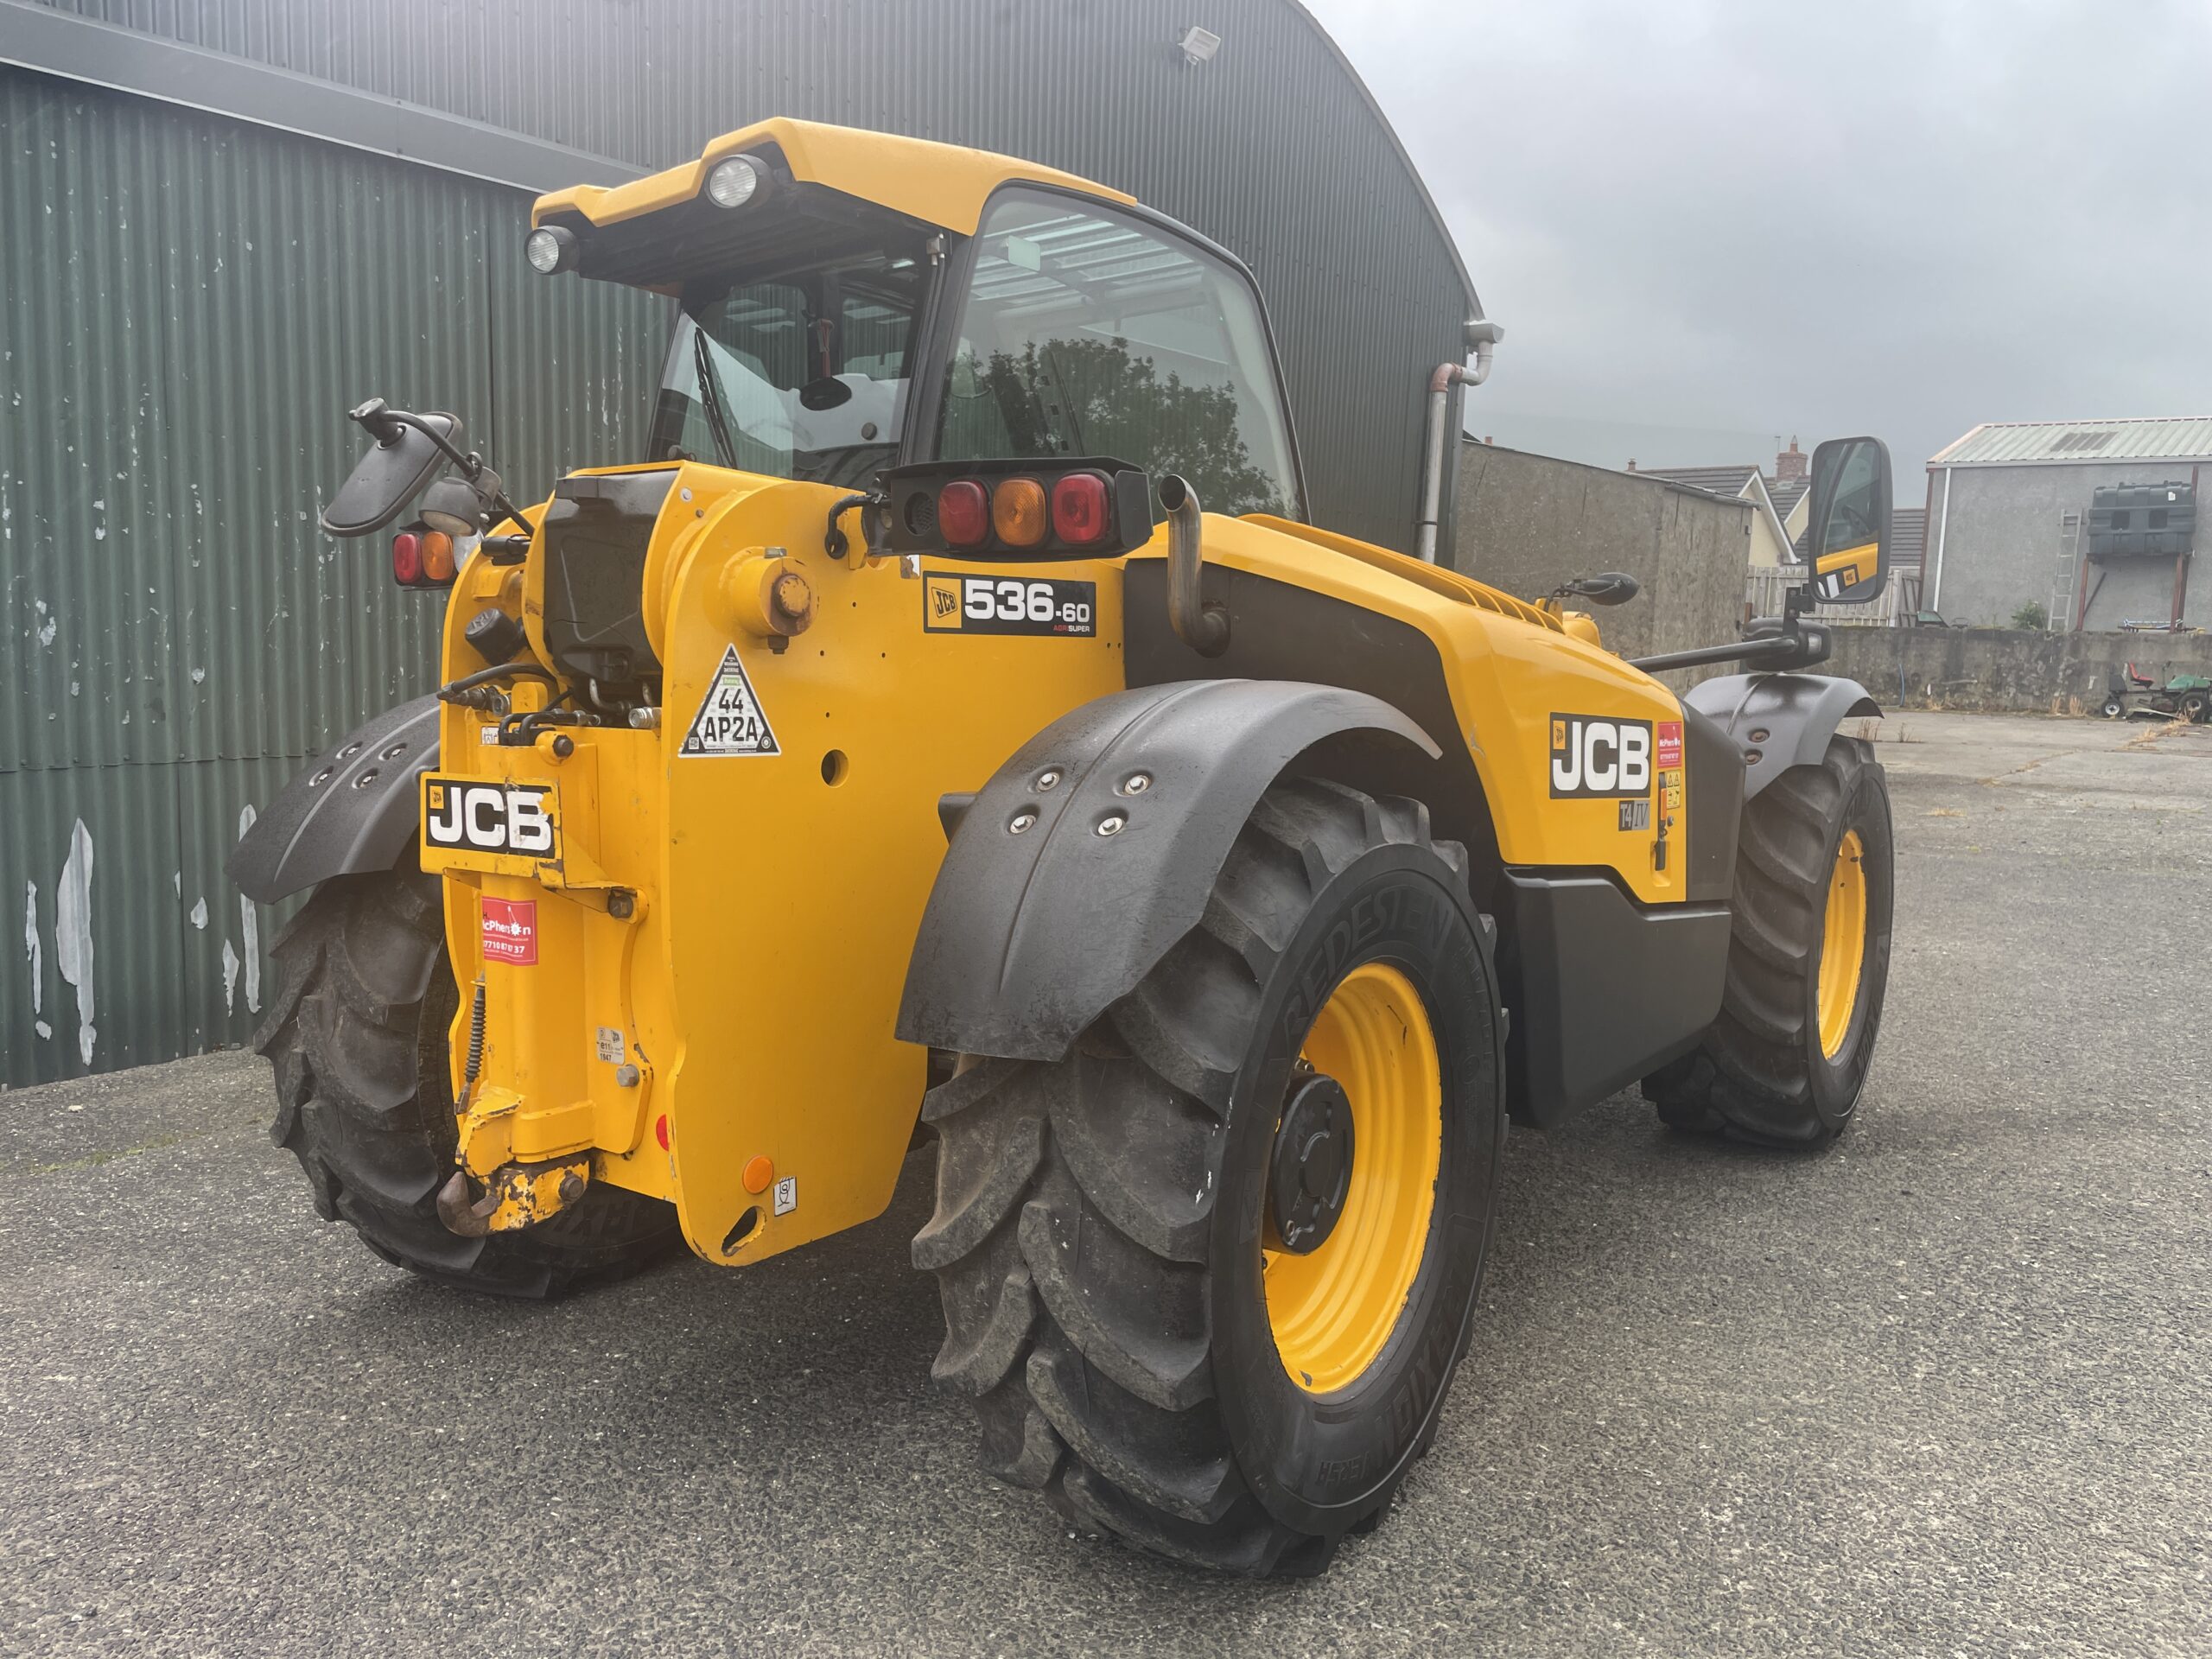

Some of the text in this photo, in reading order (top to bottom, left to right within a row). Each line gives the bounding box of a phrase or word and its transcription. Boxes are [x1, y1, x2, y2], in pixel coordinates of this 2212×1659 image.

[935, 590, 957, 615] JCB
[719, 688, 743, 715] 44
[1553, 721, 1650, 791] JCB
[429, 786, 552, 851] JCB
